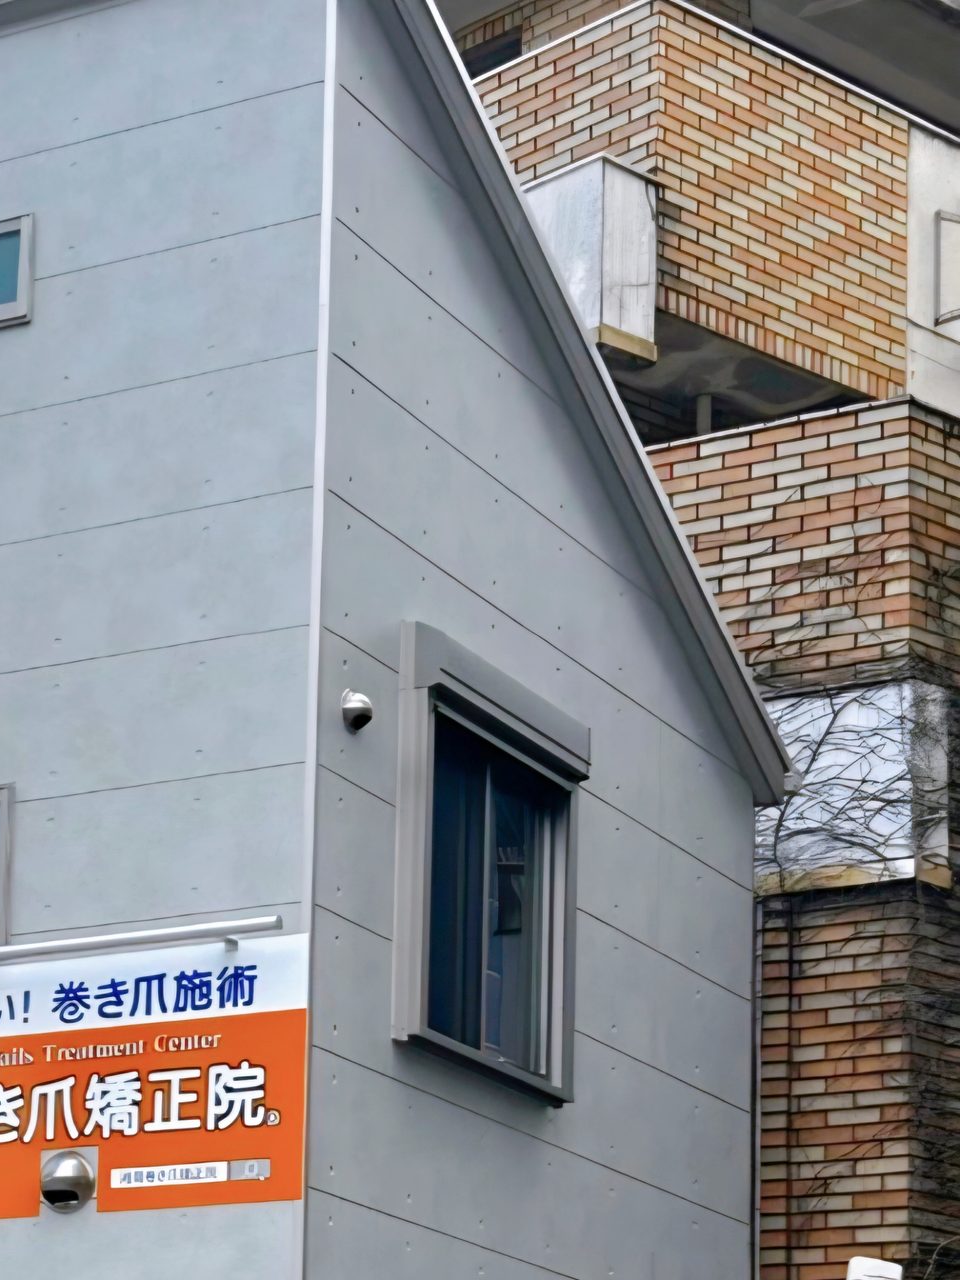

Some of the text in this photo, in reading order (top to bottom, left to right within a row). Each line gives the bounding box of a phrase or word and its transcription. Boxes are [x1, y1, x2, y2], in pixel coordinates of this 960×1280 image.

[51, 964, 259, 1022] 巻き爪施術
[153, 1034, 222, 1053] Center
